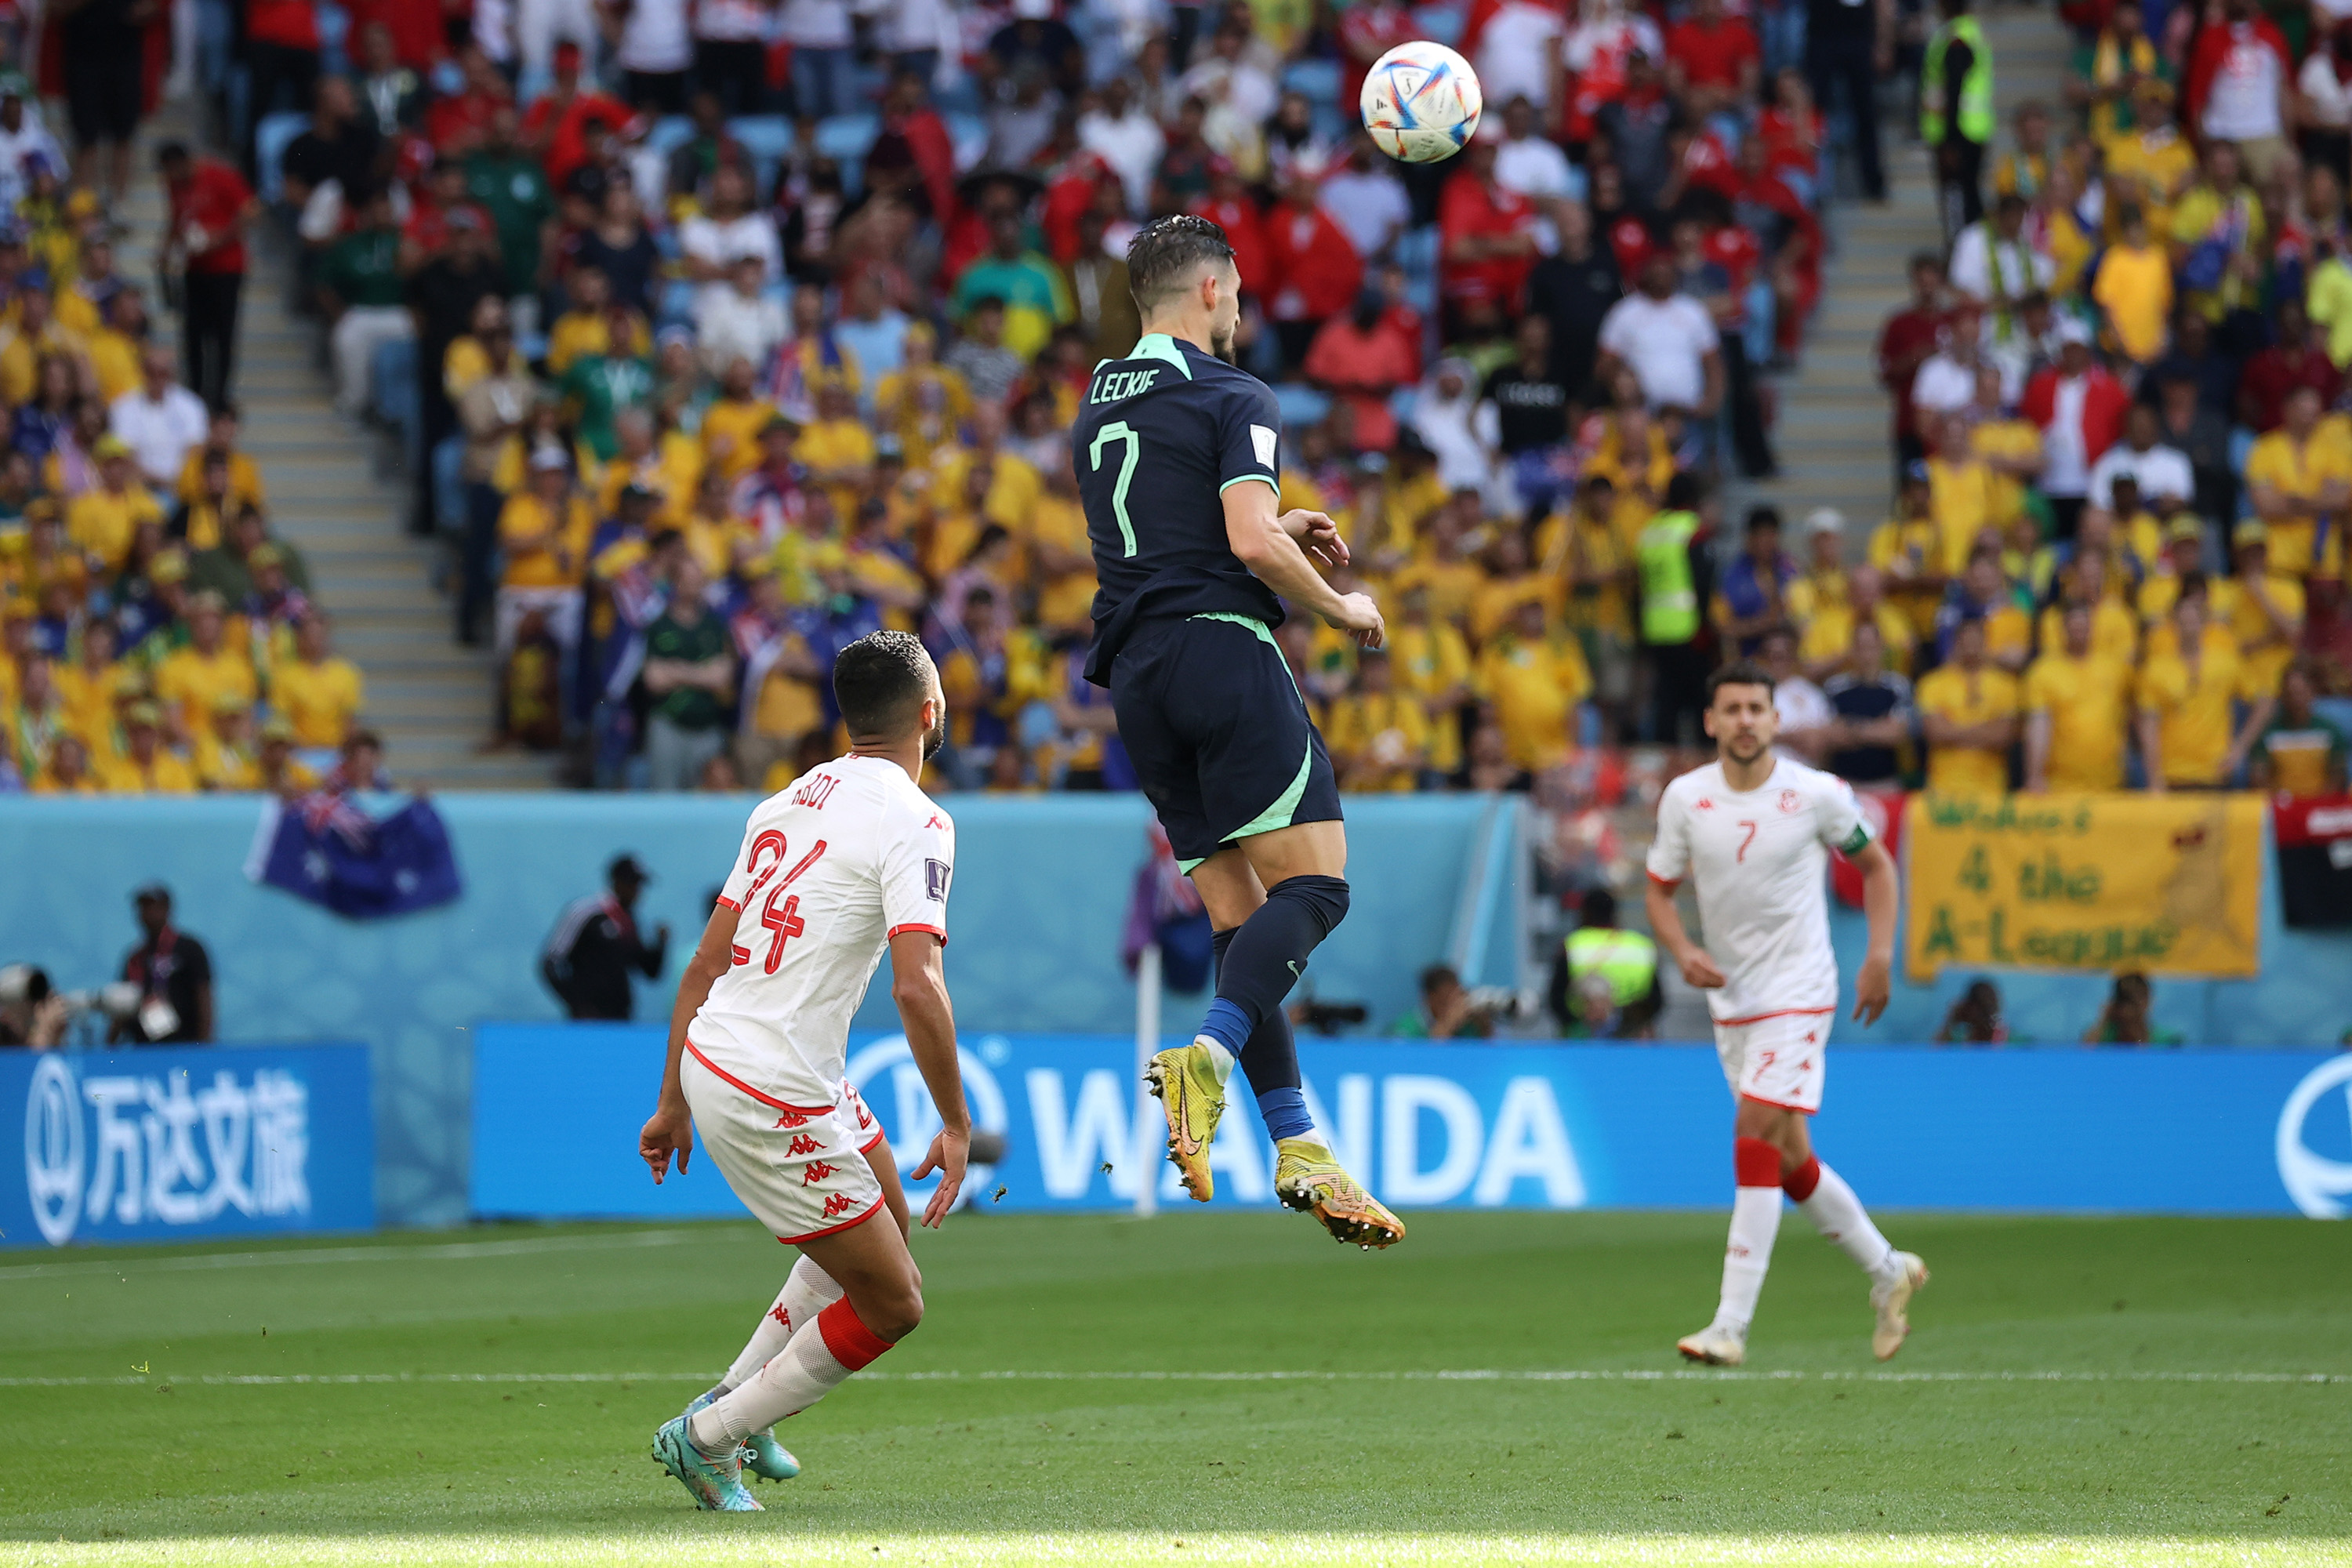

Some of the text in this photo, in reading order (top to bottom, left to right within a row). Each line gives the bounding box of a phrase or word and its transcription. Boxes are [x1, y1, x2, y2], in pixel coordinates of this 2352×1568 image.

[1089, 420, 1140, 558] 7
[1738, 819, 1759, 864] 7
[1957, 844, 2103, 903] 4 the
[731, 829, 828, 975] 24
[1751, 1051, 1777, 1084] 7
[1025, 1067, 1588, 1207] WANDA
